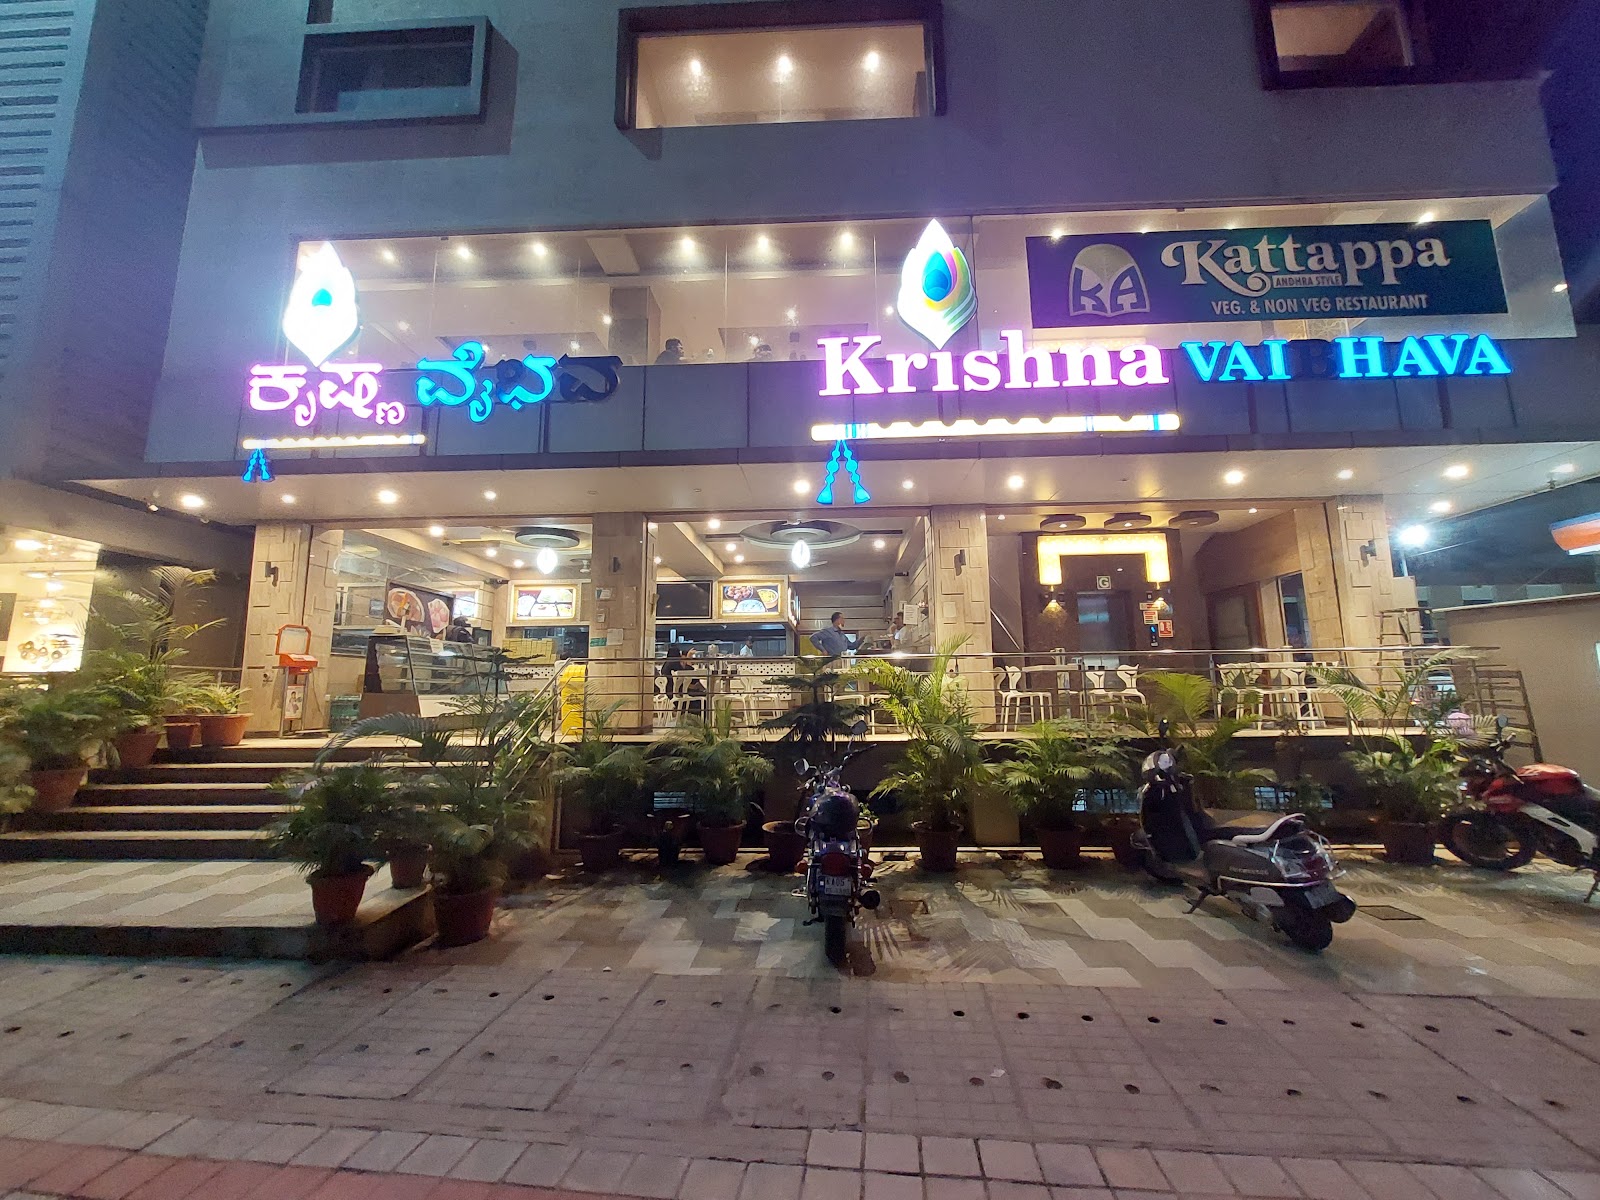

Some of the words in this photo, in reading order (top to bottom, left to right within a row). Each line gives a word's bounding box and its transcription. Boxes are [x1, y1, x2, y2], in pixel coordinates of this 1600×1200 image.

[1161, 234, 1451, 297] Kattappa
[1275, 276, 1314, 287] ANDHRA
[1315, 275, 1341, 286] STYLE
[1211, 300, 1245, 315] VEG.
[1250, 300, 1261, 314] &
[1265, 298, 1298, 314] NON
[1302, 297, 1331, 312] VEG
[1336, 294, 1428, 311] RESTAURANT
[248, 361, 406, 427] ಕೃಷ್ಣ
[816, 329, 1171, 397] Krishna
